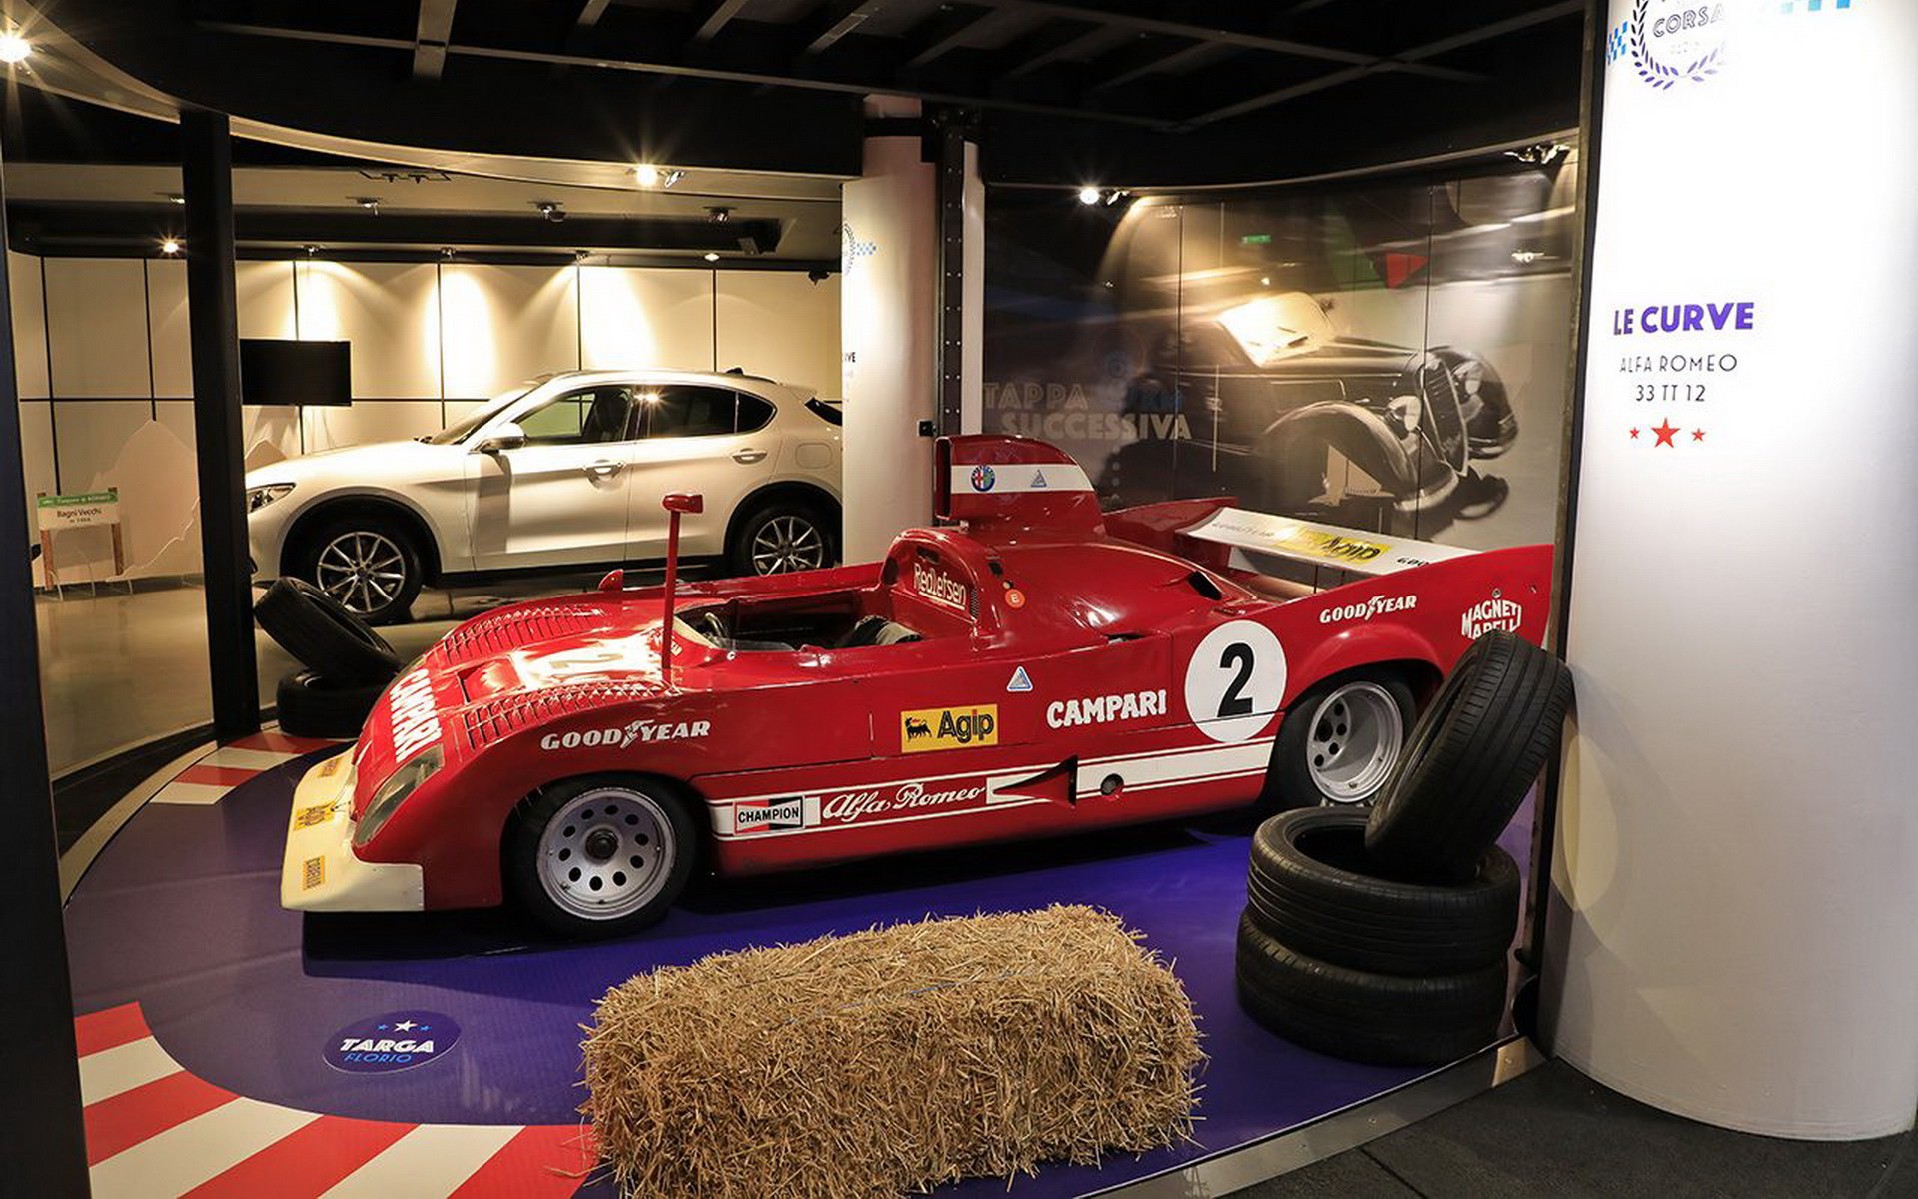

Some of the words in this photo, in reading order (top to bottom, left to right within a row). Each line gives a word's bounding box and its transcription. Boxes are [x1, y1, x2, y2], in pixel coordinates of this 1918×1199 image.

[1652, 3, 1725, 38] CORSA
[1613, 308, 1634, 336] LE
[1640, 302, 1755, 334] CURVE
[1619, 355, 1653, 373] ALFA
[1659, 353, 1738, 373] ROMEO
[983, 382, 1089, 410] TAPPA
[1635, 384, 1655, 402] 33
[1661, 384, 1678, 401] TT
[1686, 384, 1706, 402] 12
[1001, 411, 1193, 441] SUCCESSIVA
[1319, 595, 1418, 624] GOODYEAR
[1217, 641, 1255, 718] 2
[389, 667, 444, 764] CAMPARI
[1045, 688, 1168, 729] CAMPARI
[539, 718, 712, 752] GOODYEAR
[937, 709, 995, 741] Agip
[737, 803, 800, 824] CHAMPION
[822, 790, 891, 823] Alfa
[892, 781, 986, 811] Romeo
[339, 1038, 435, 1053] TARGA
[344, 1052, 413, 1063] FLORIO
